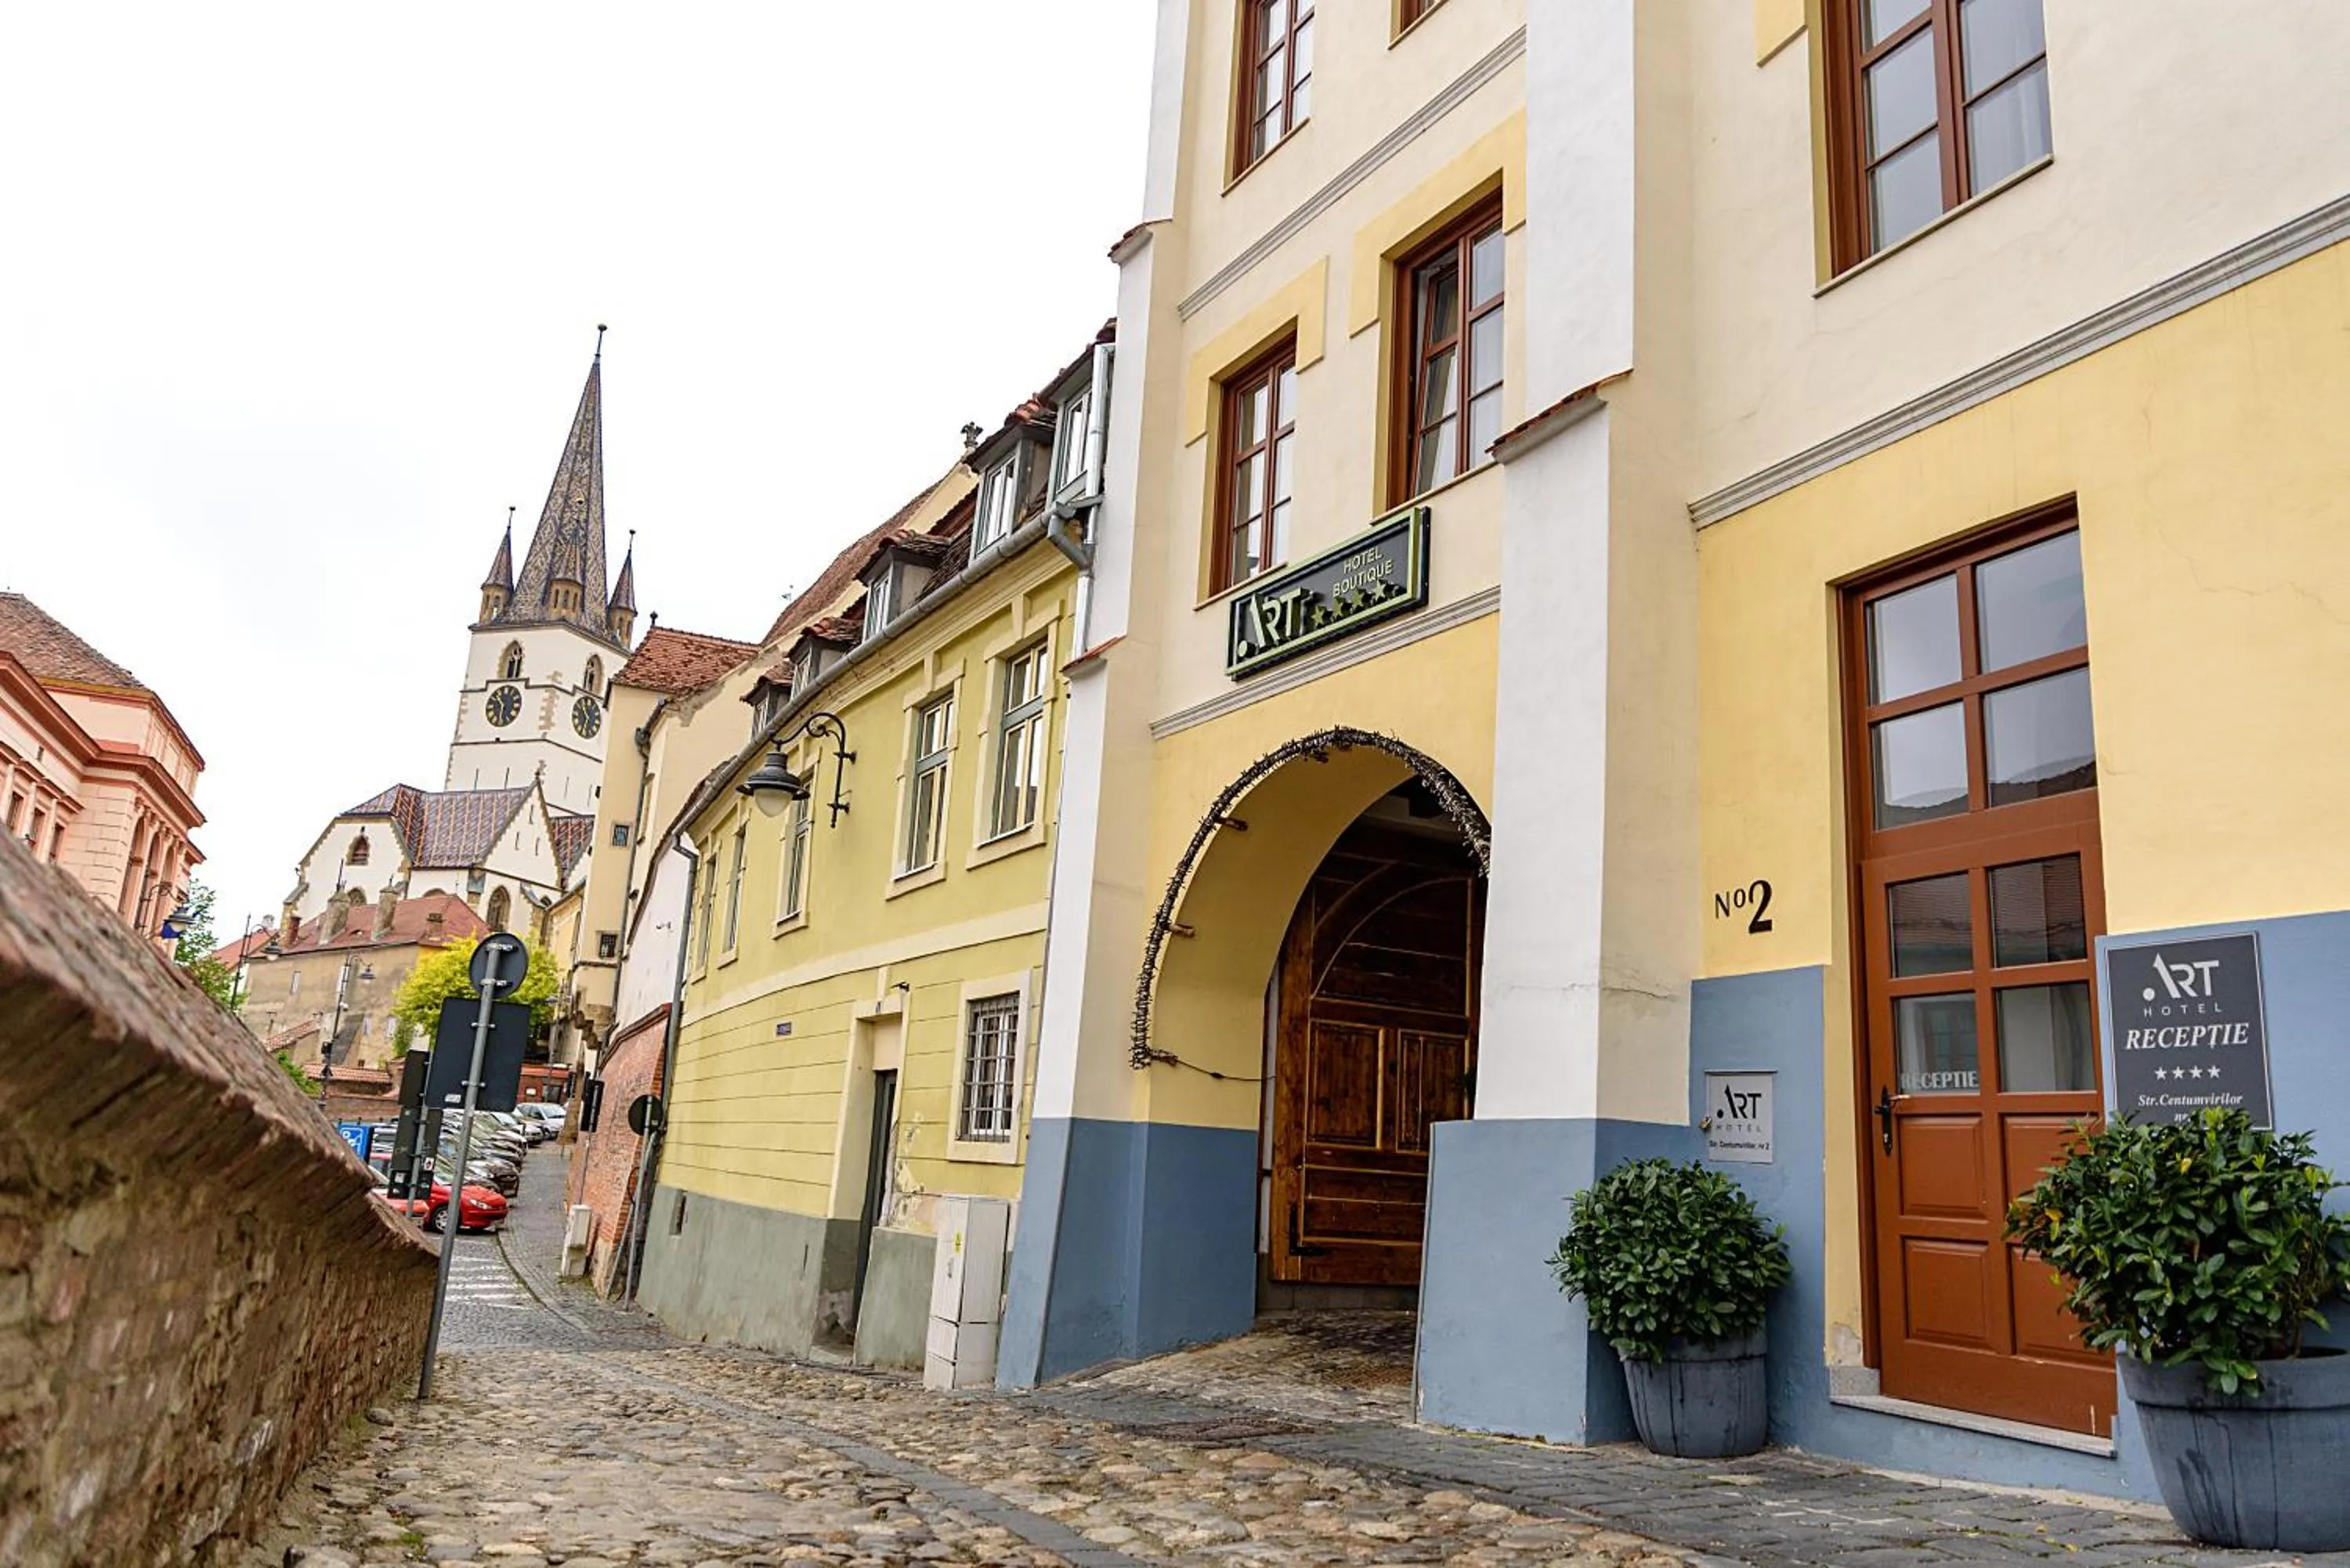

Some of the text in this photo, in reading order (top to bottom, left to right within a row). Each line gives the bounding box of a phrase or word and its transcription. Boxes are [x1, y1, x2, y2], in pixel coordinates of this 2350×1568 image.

[1343, 546, 1383, 574] HOTEL
[1332, 558, 1393, 598] BOUTIQUE
[2143, 1003, 2222, 1017] HOTEL
